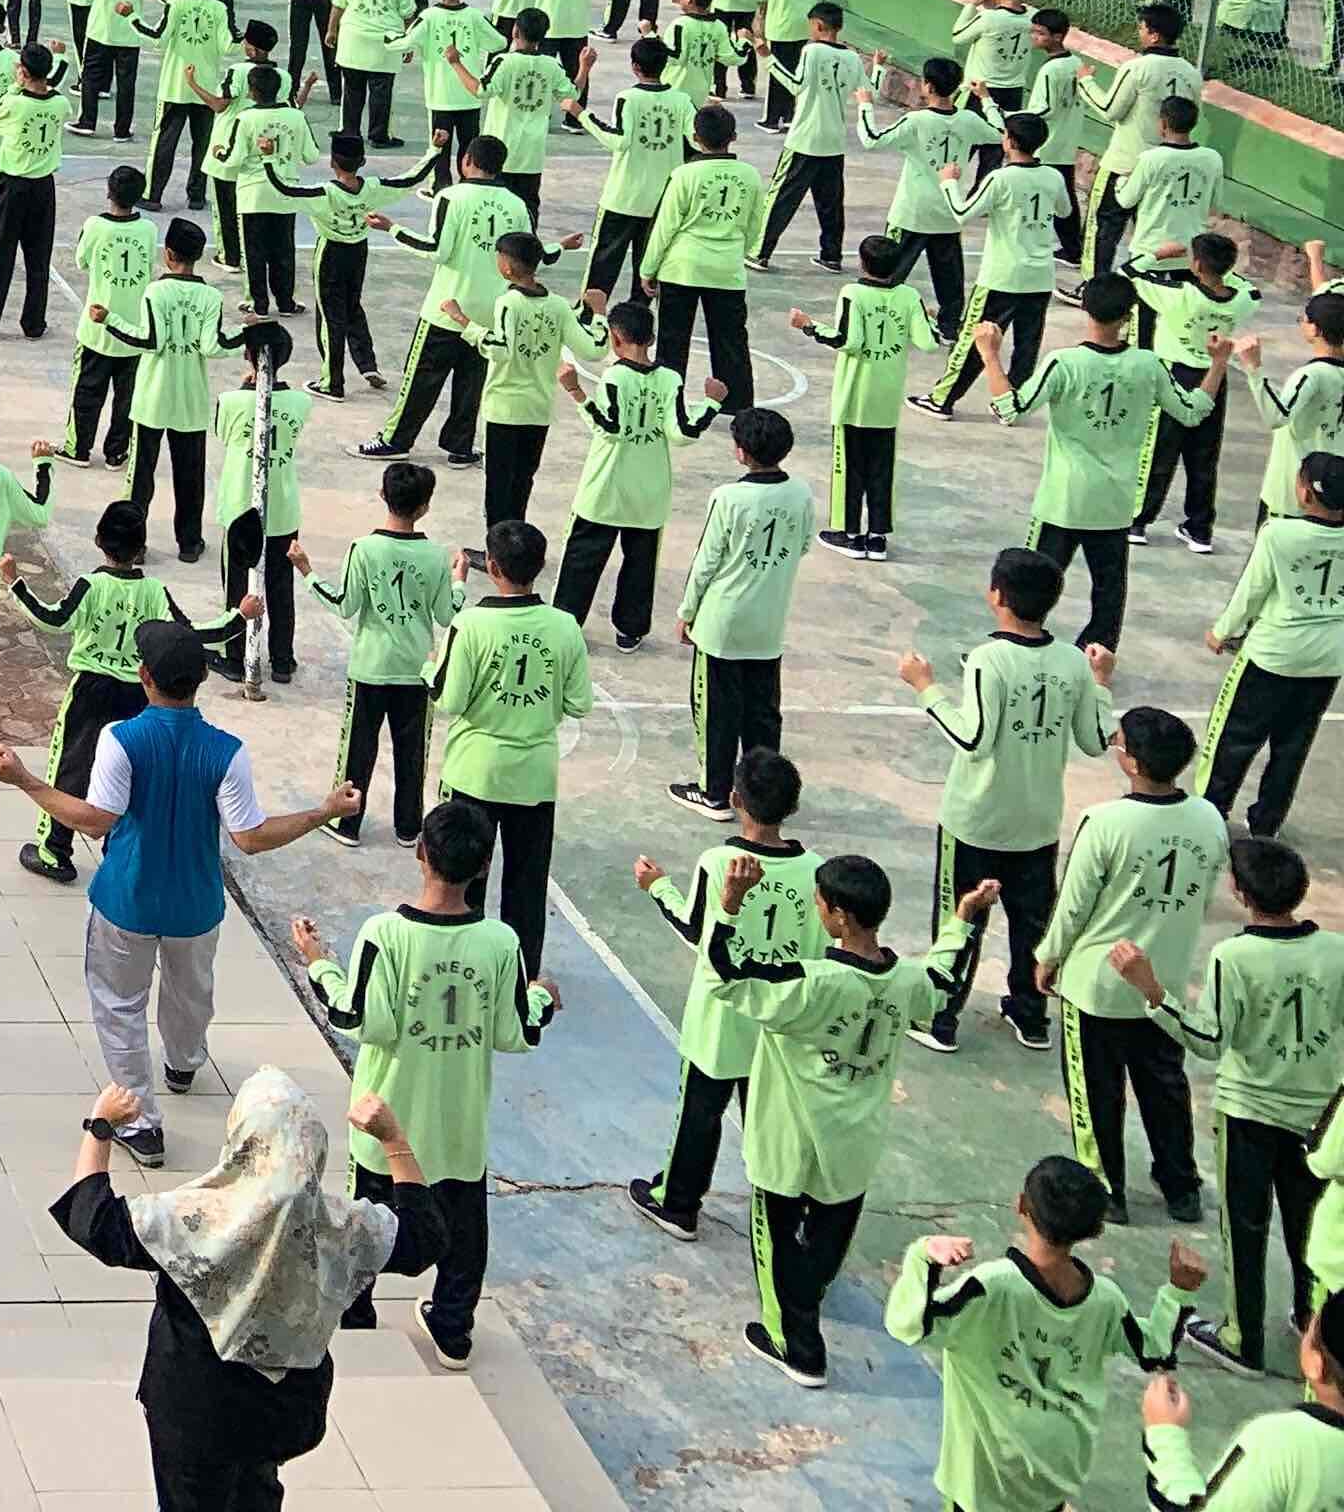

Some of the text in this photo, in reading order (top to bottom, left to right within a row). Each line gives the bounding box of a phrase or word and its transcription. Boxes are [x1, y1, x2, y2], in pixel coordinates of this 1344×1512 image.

[194, 17, 200, 33] 1
[449, 30, 455, 47] 1
[700, 42, 708, 59] 1
[1011, 33, 1021, 55] 1
[526, 80, 532, 101] 1
[40, 123, 47, 143] 1
[654, 118, 662, 138] 1
[275, 135, 280, 153] 1
[939, 137, 949, 163] 1
[720, 186, 728, 207] 1
[1178, 172, 1190, 198] 1
[1030, 193, 1040, 221] 1
[488, 214, 495, 238] 1
[116, 237, 148, 265] NEGERI
[121, 249, 129, 273] 1
[103, 269, 145, 288] BATAM
[182, 314, 187, 338] 1
[875, 305, 905, 336] NEGERI
[877, 320, 885, 345] 1
[1102, 381, 1113, 417] 1
[270, 409, 295, 438] EGERI
[639, 402, 646, 428] 1
[763, 518, 776, 557] 1
[392, 569, 405, 610] 1
[1313, 559, 1333, 596] 1
[92, 609, 111, 635] MTs
[377, 599, 421, 625] BATAM
[115, 620, 128, 652] 1
[491, 633, 553, 676] MTs NEGERI
[515, 654, 527, 685] 1
[491, 679, 551, 708] BATAM
[1032, 684, 1046, 728] 1
[1158, 848, 1177, 895] 1
[760, 881, 807, 928] NEGERI
[1134, 882, 1201, 912] BATAM
[763, 903, 777, 940] 1
[408, 960, 490, 1011] MTs NEGERI
[441, 985, 456, 1025] 1
[1283, 987, 1303, 1043] 1
[410, 1020, 483, 1052] BATAM
[860, 1017, 875, 1056] 1
[1268, 1031, 1330, 1063] BATAM
[1033, 1356, 1050, 1388] 1
